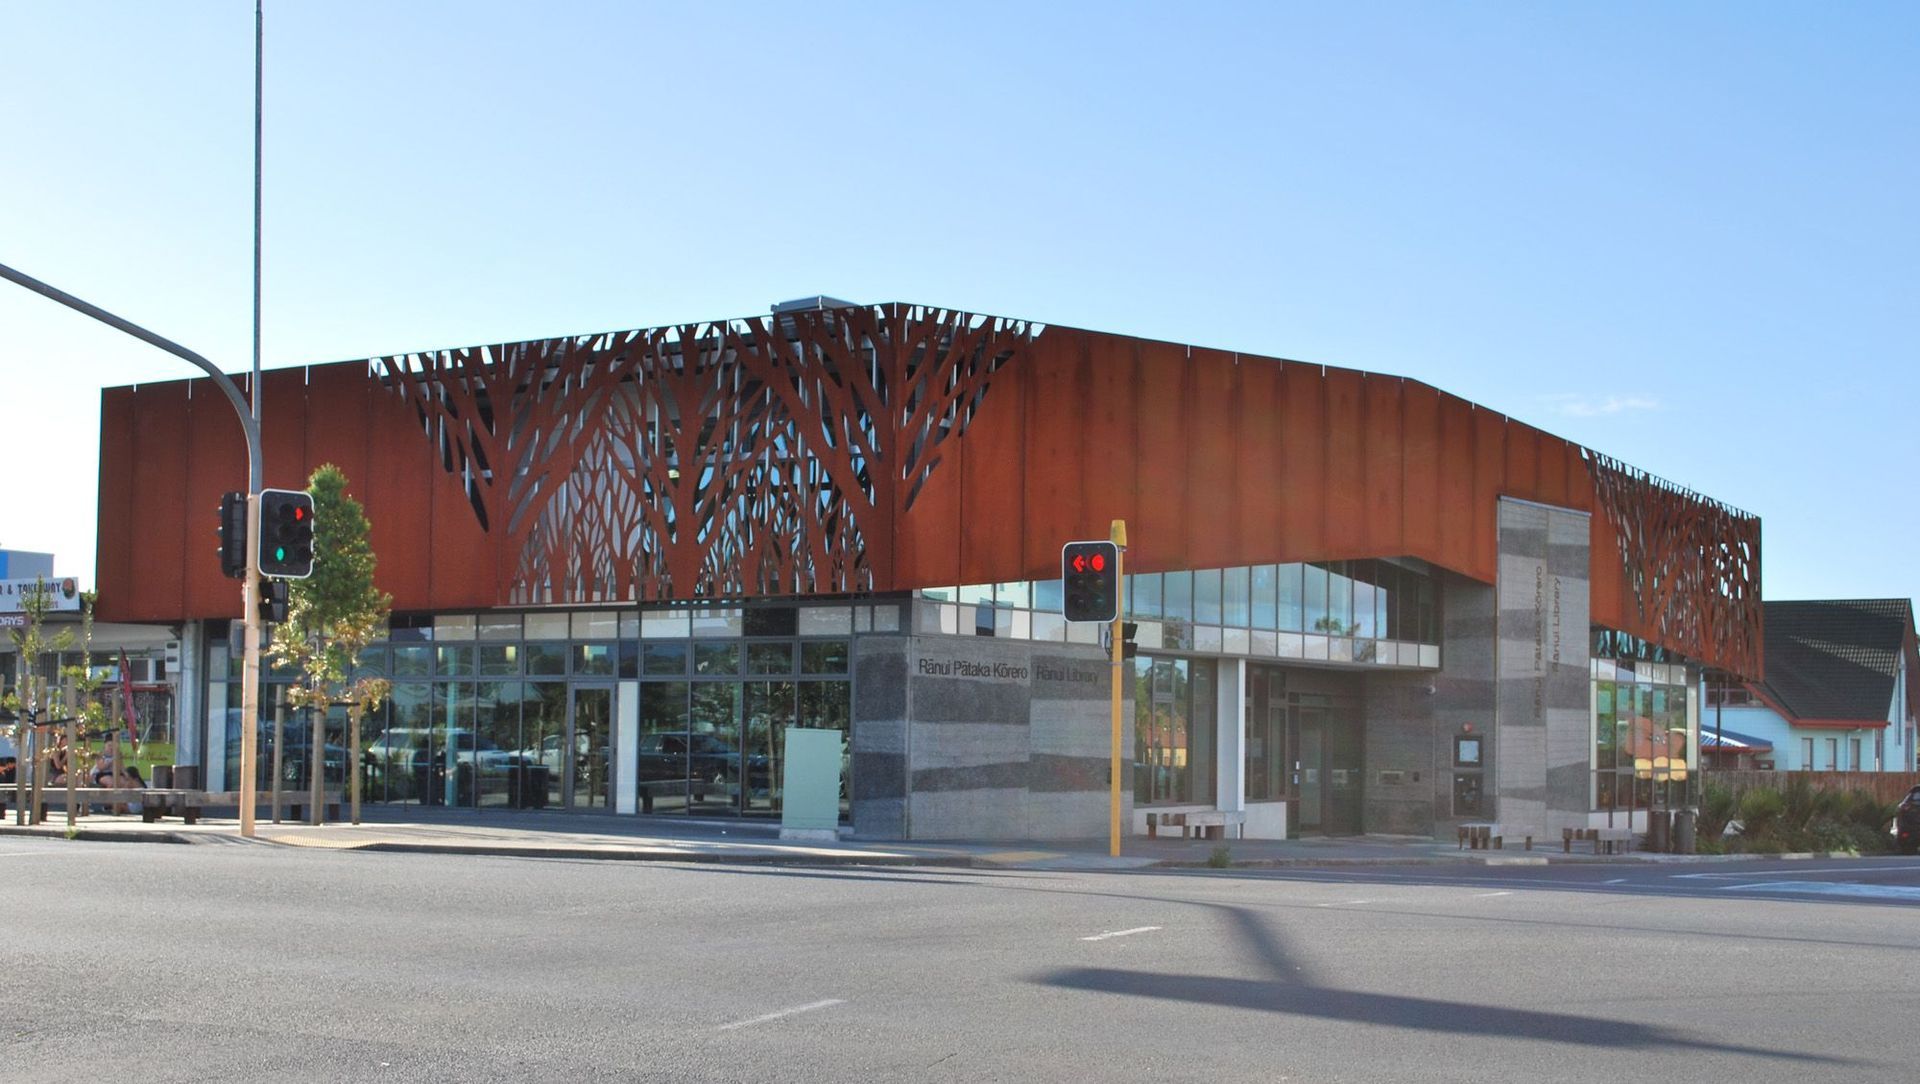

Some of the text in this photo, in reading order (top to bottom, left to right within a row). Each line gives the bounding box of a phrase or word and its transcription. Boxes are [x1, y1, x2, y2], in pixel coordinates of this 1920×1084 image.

[18, 582, 61, 595] TAKEWAY
[919, 658, 1028, 680] Rānui Pātaka Kōrero
[1066, 667, 1099, 687] Library
